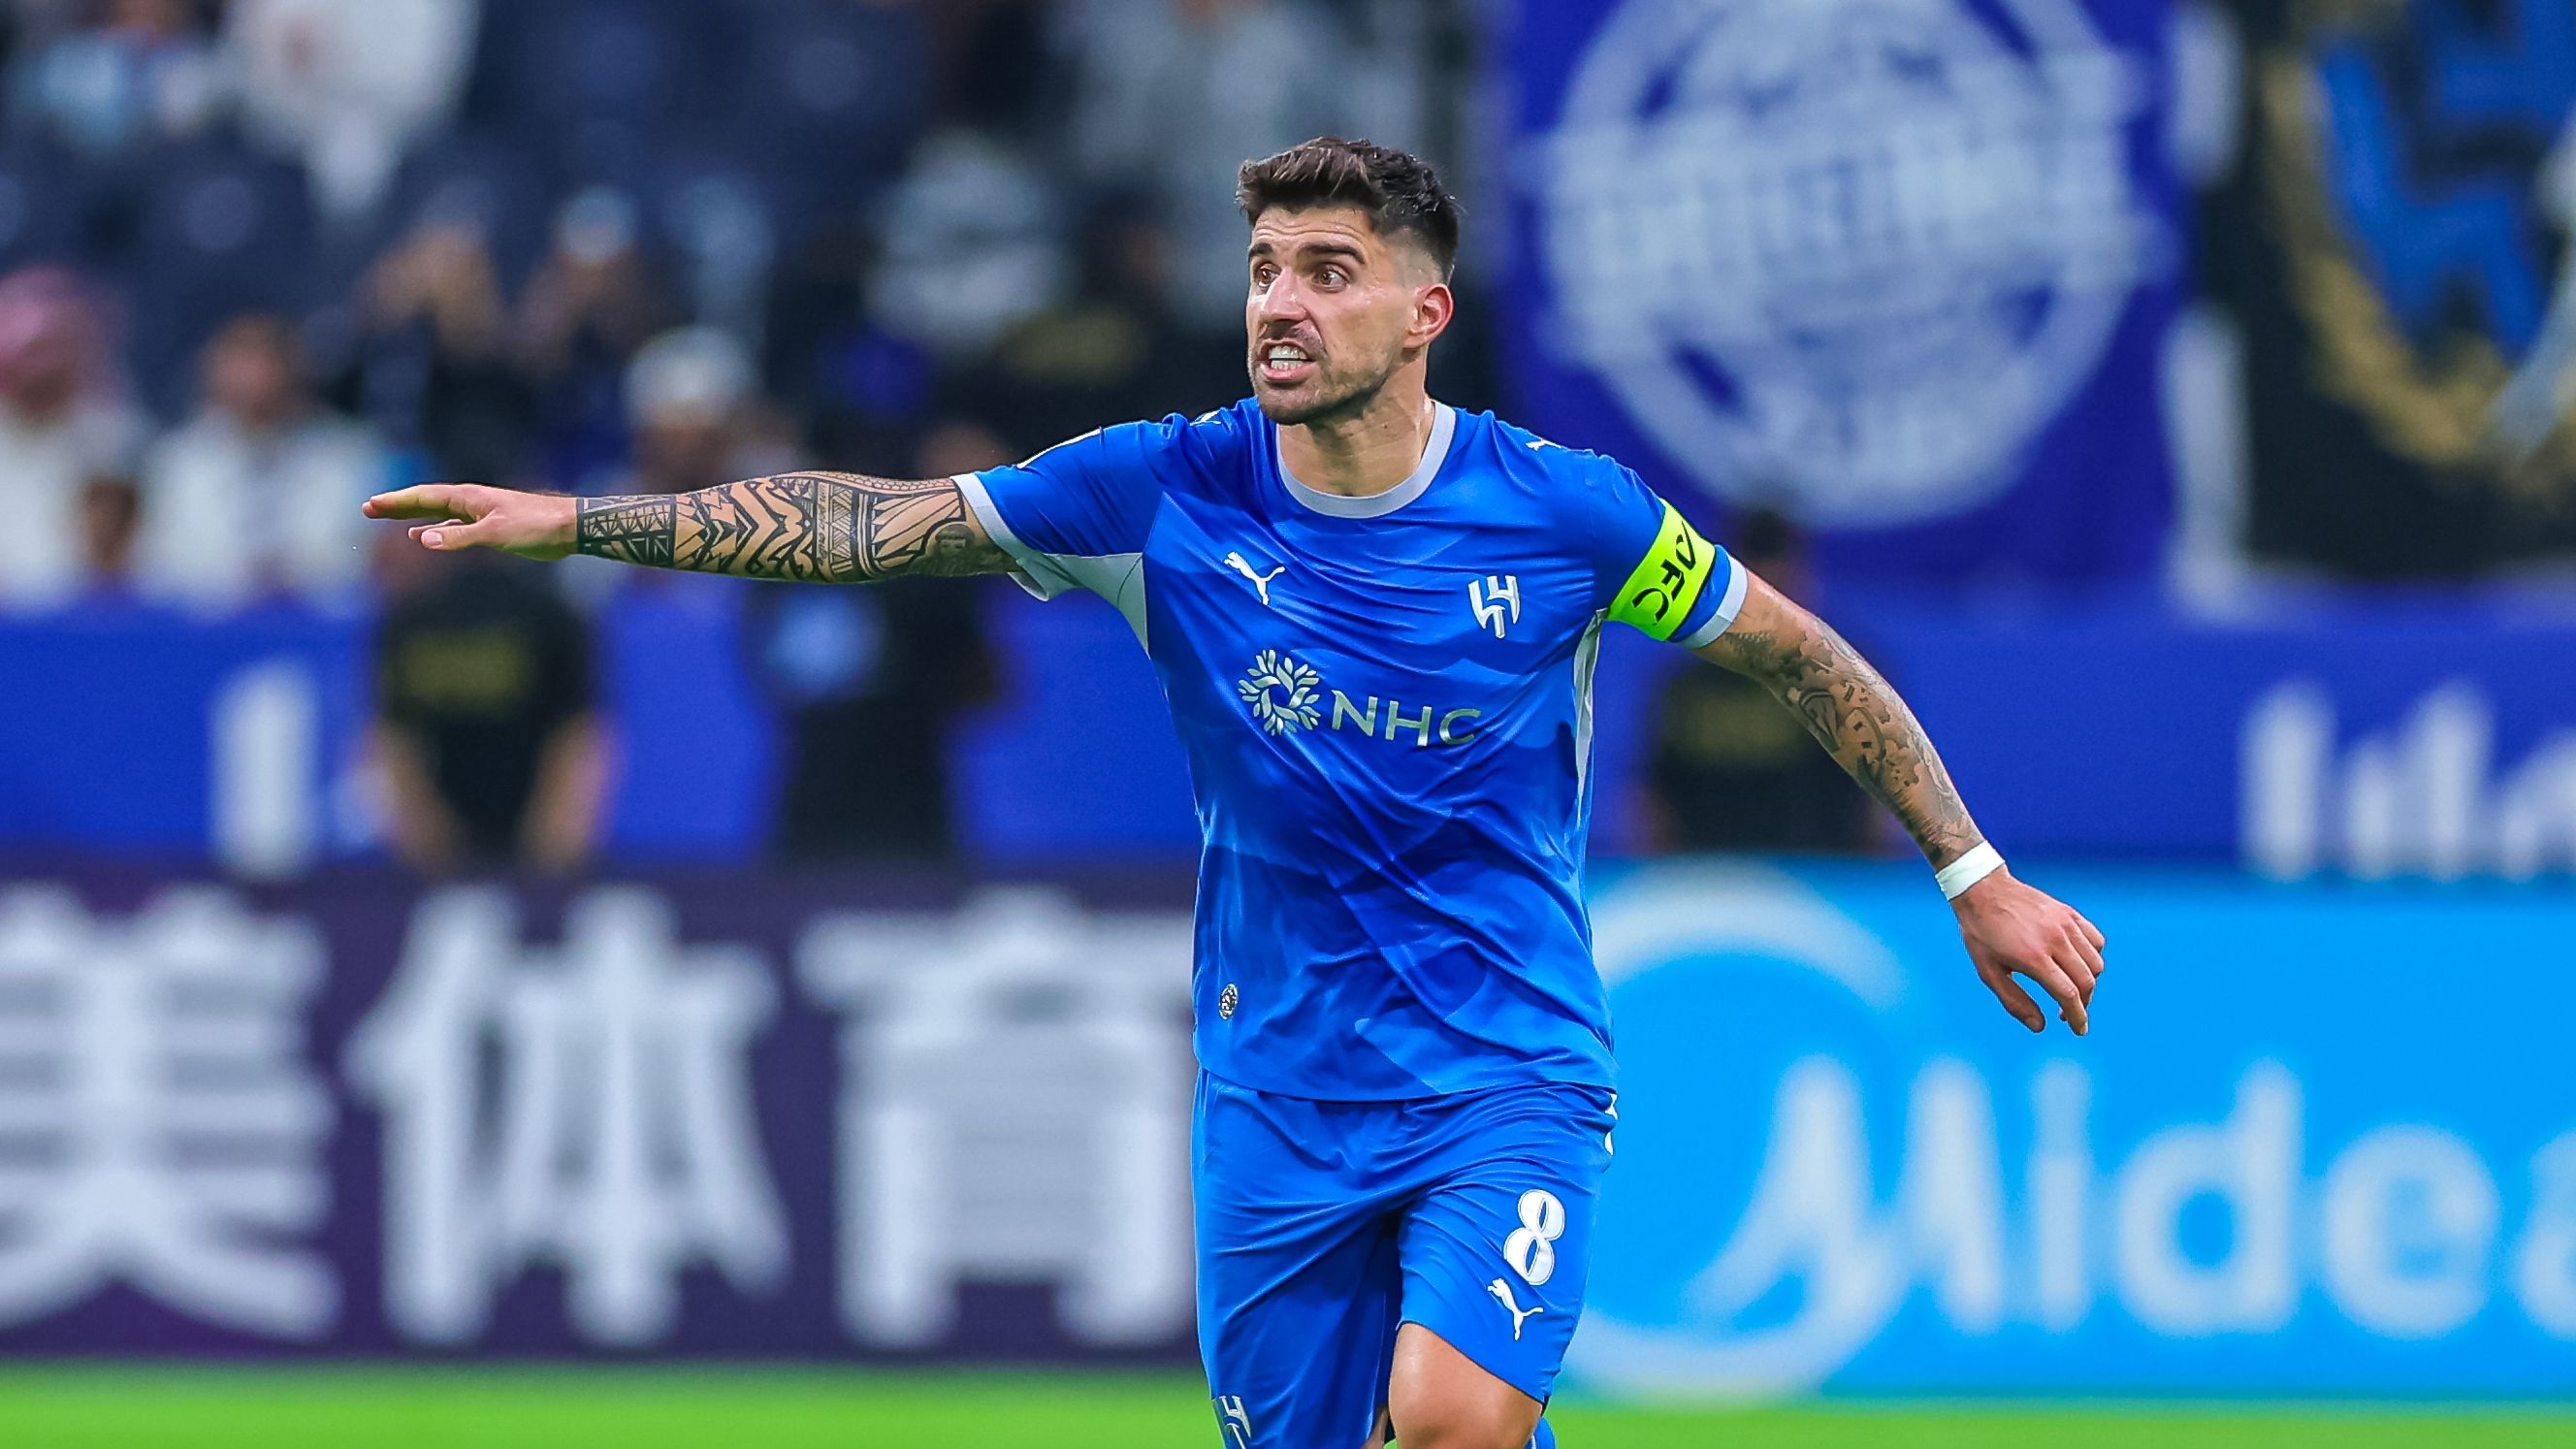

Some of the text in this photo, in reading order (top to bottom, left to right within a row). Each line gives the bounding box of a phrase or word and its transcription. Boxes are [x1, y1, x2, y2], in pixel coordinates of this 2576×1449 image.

[1631, 520, 1696, 627] AFC
[1331, 689, 1482, 747] NHC
[1503, 1188, 1565, 1286] 8
